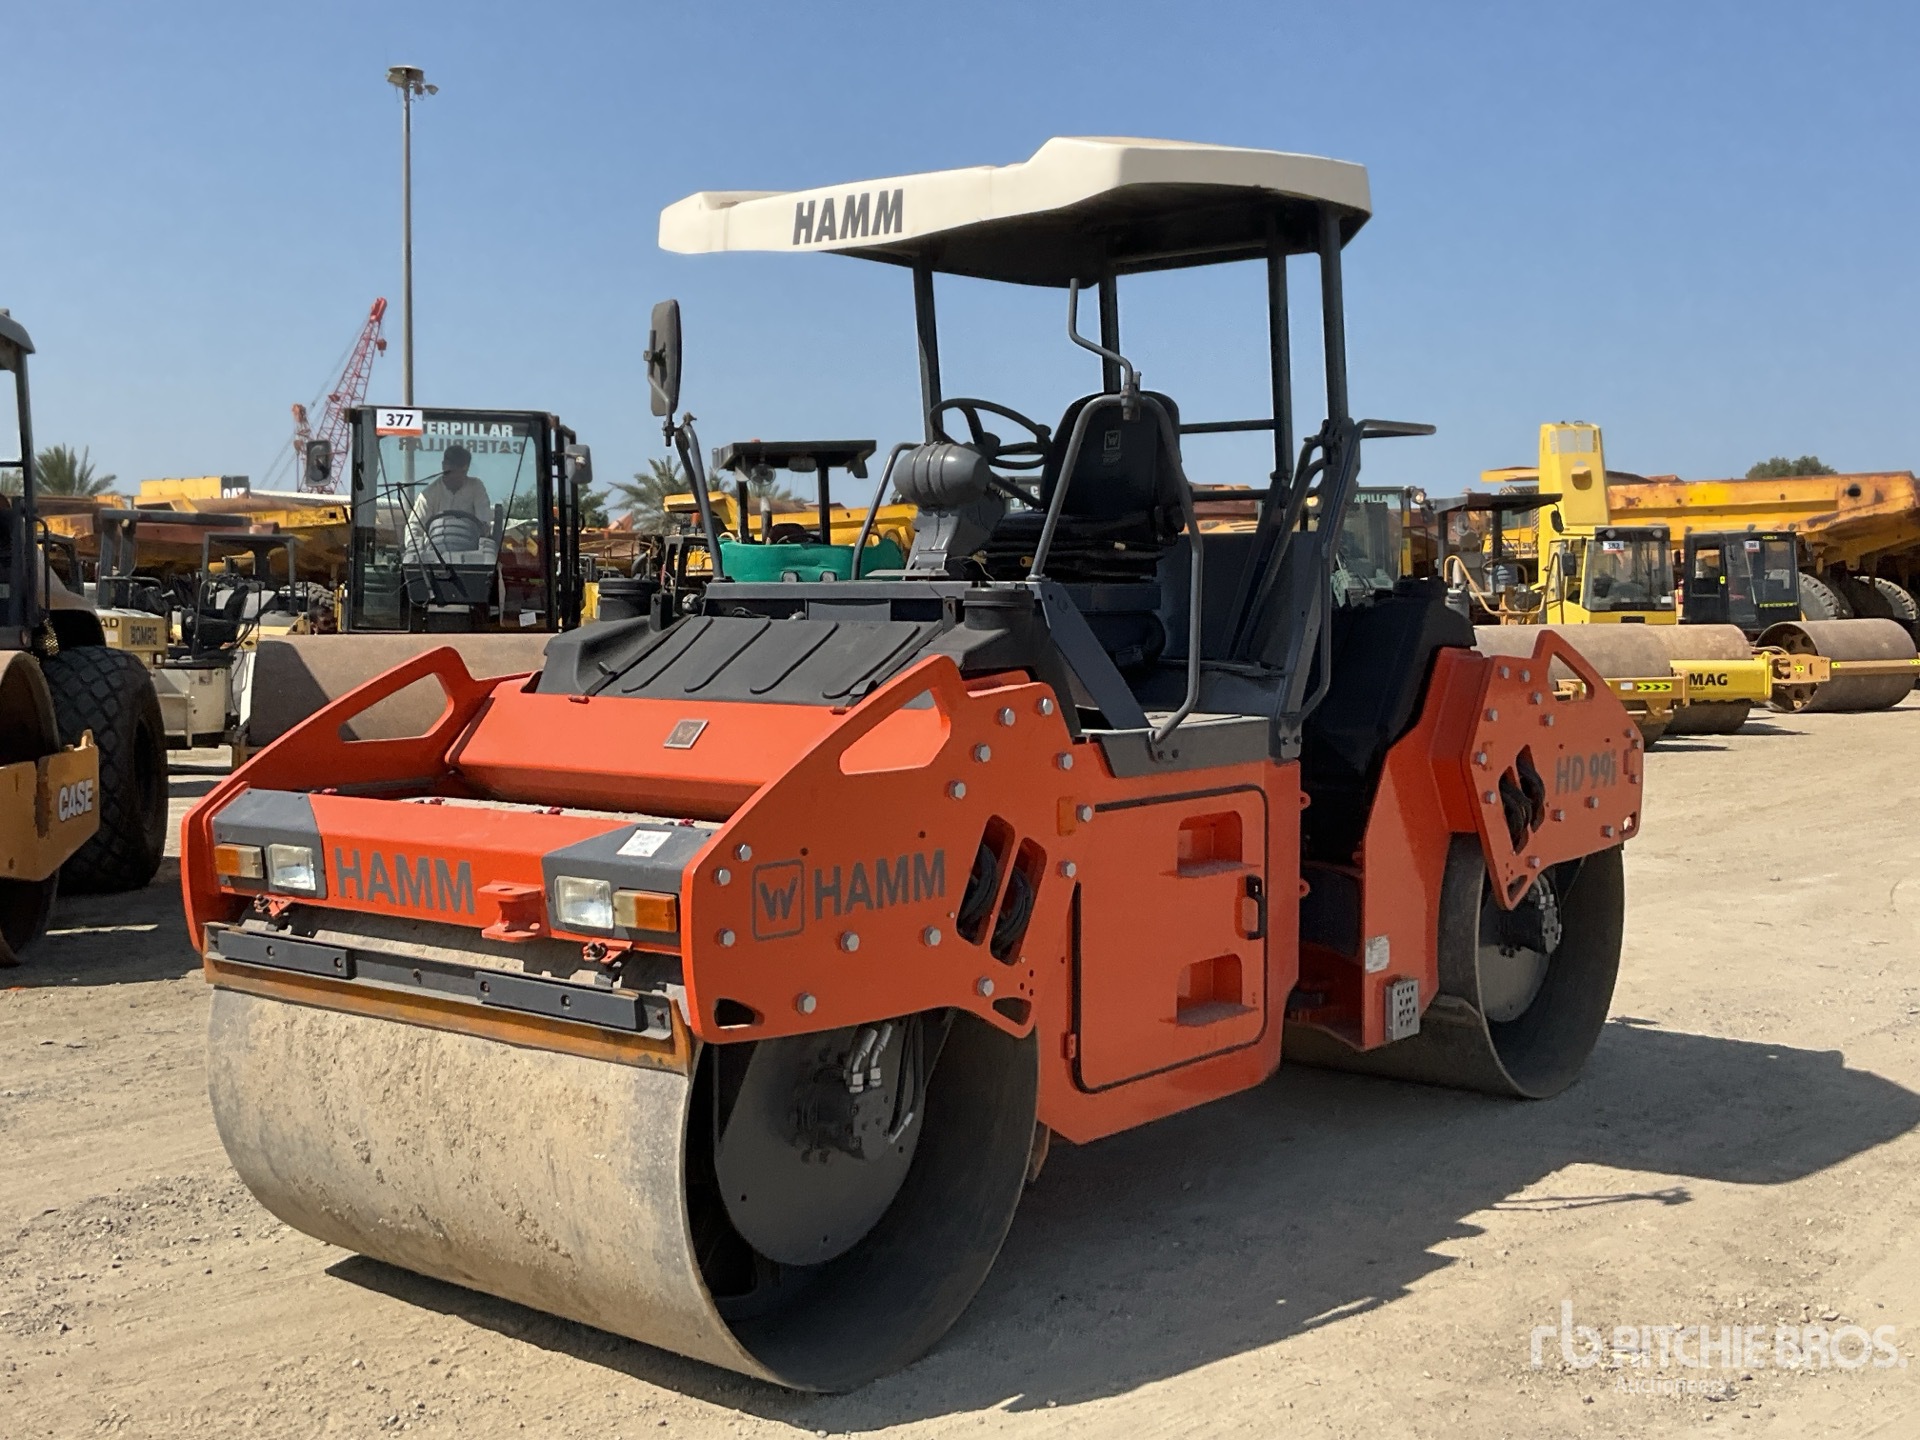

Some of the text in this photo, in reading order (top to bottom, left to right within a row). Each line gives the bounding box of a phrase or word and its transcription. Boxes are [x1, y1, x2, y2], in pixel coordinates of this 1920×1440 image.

[793, 188, 903, 245] HAMM
[386, 413, 414, 427] 377
[1556, 748, 1617, 795] HD 99i
[59, 779, 94, 822] CASE
[335, 847, 476, 915] HAMM
[814, 848, 945, 920] HAMM
